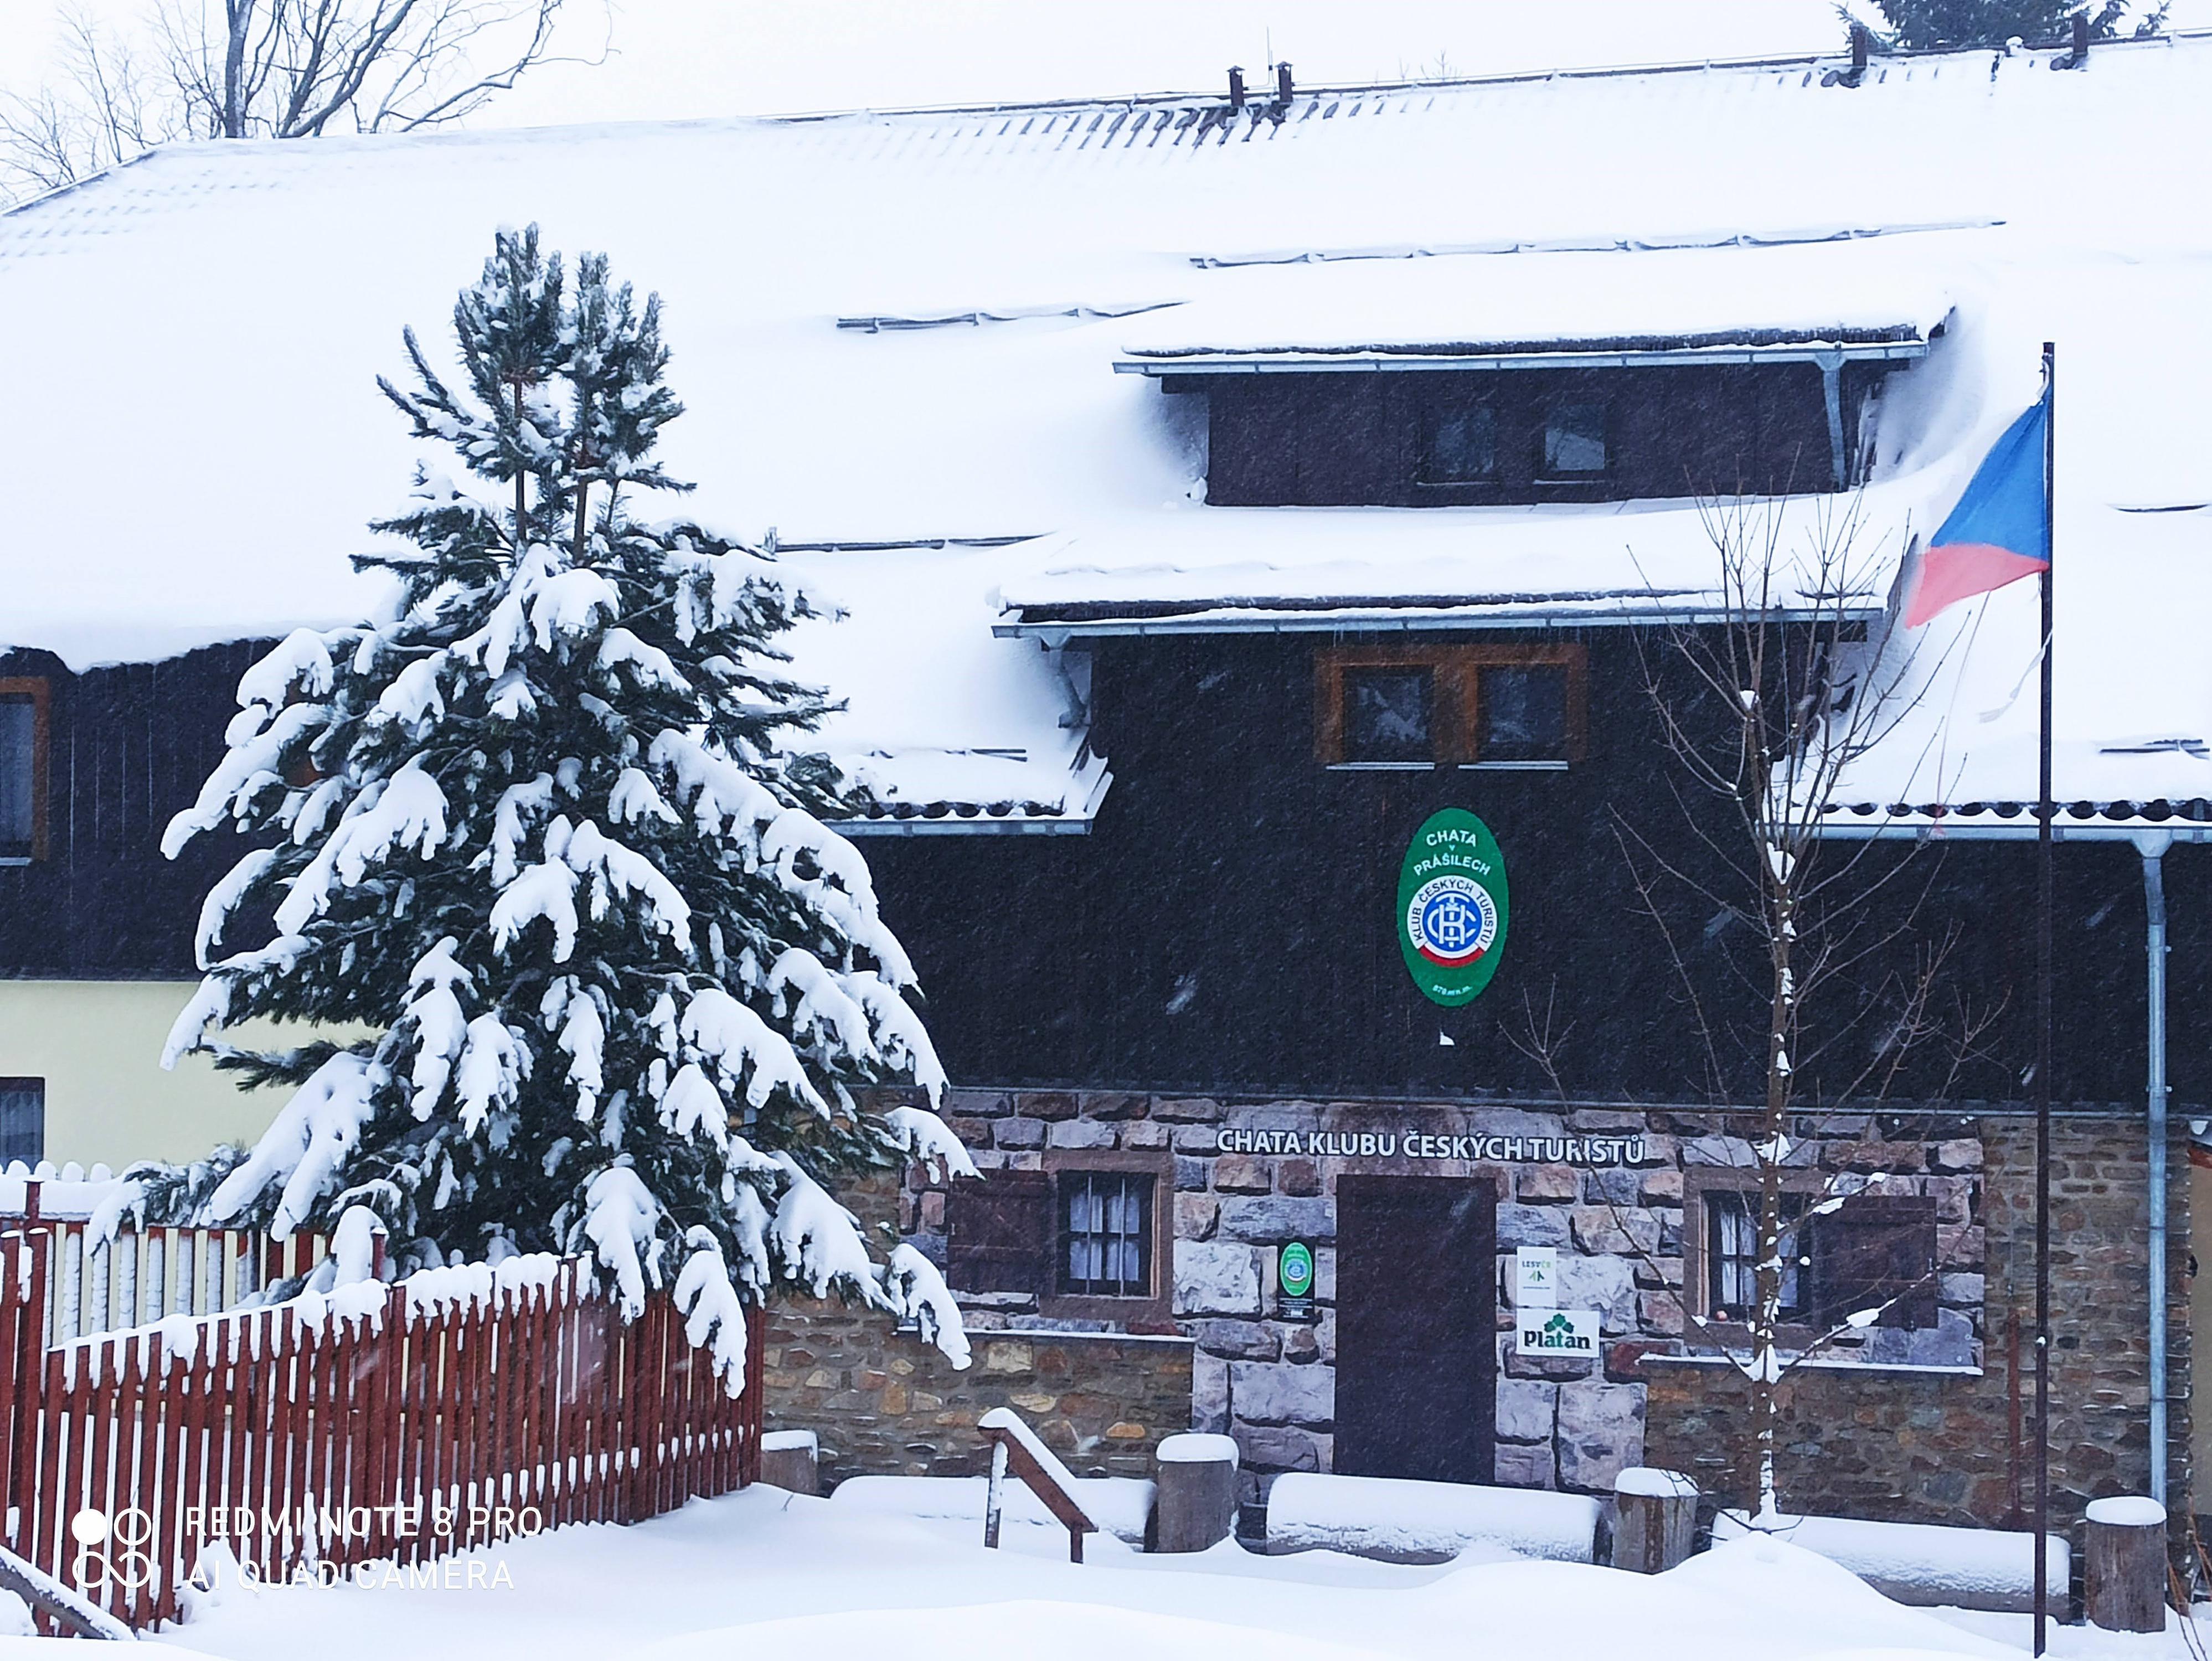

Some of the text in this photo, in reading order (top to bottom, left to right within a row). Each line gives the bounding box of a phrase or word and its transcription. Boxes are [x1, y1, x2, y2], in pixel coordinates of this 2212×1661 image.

[1426, 829, 1477, 848] CHATA
[1413, 853, 1491, 876] PRÁŠILECH
[1411, 907, 1424, 941] KLUB
[1216, 1129, 1644, 1163] CHATA KLUBU ČESKÝCH TURISTŮ
